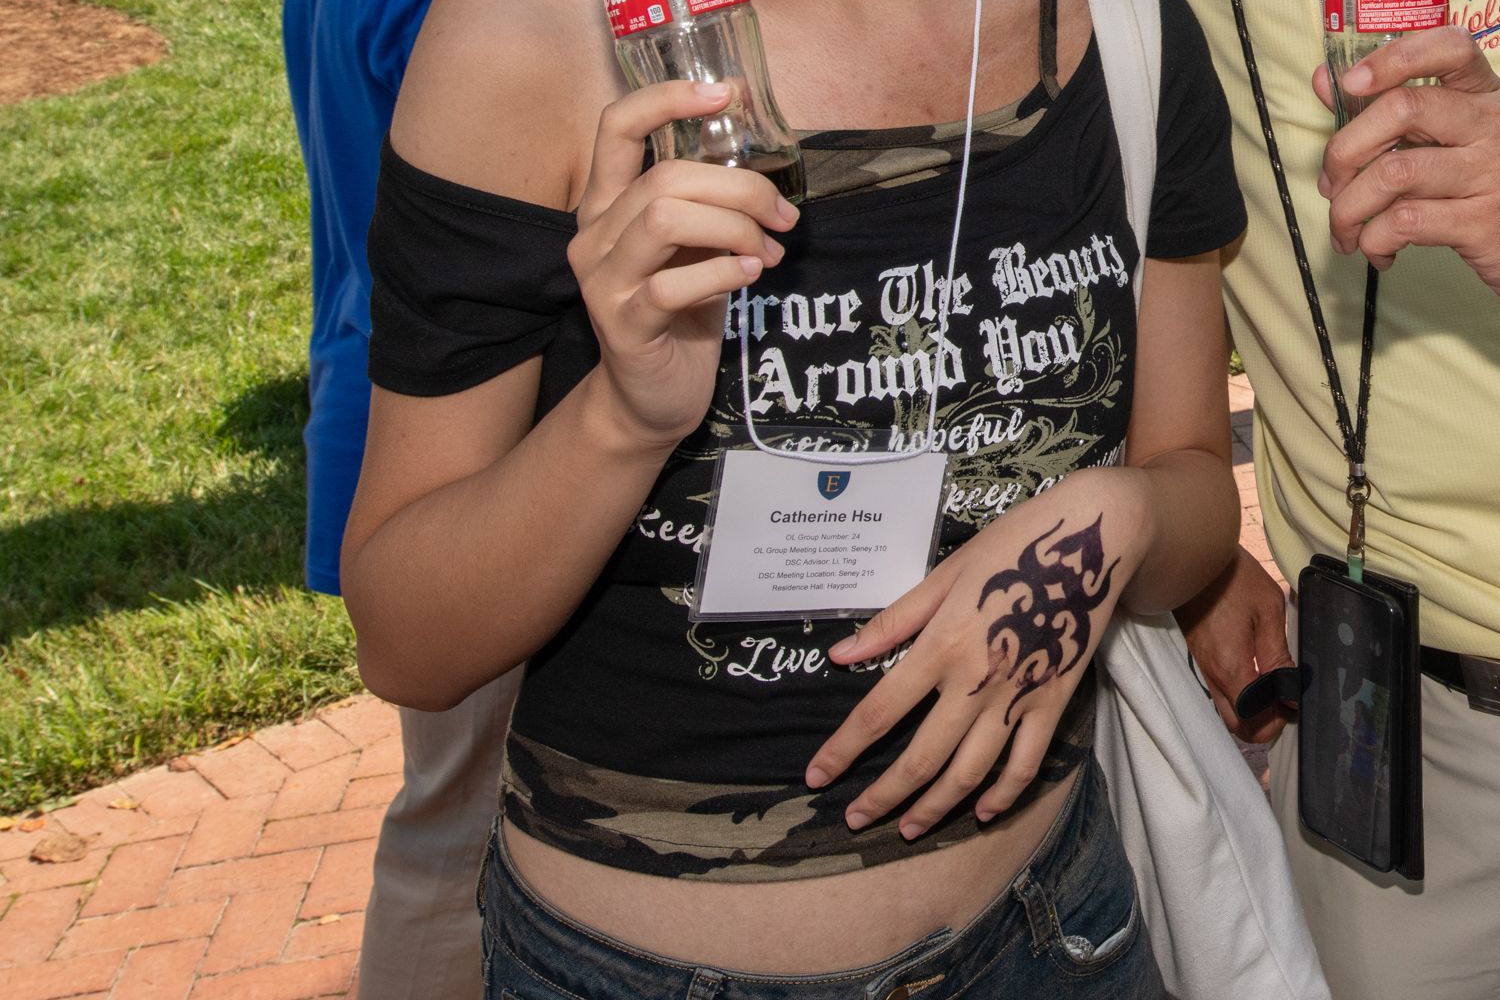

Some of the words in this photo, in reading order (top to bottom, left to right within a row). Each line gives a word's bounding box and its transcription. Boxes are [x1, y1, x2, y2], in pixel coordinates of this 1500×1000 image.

[723, 289, 863, 342] race
[878, 259, 974, 326] The
[988, 233, 1128, 307] Beauty
[750, 321, 967, 415] Around
[980, 315, 1083, 395] You
[888, 408, 1027, 456] hopeful
[825, 475, 841, 493] E
[944, 482, 1021, 514] keep
[770, 510, 847, 523] Catherine
[851, 510, 882, 522] Hsu
[797, 534, 819, 542] Group
[821, 533, 849, 541] Number:
[765, 547, 788, 555] Group
[789, 546, 817, 555] Meeting
[818, 545, 848, 553] Location:
[850, 545, 873, 554] Seney
[802, 558, 830, 566] Advisor:
[843, 558, 857, 566] Ting
[777, 571, 804, 580] Meeting
[806, 570, 835, 578] Location:
[838, 570, 860, 578] Seney
[772, 584, 809, 592] Residence
[826, 583, 858, 592] Haygood
